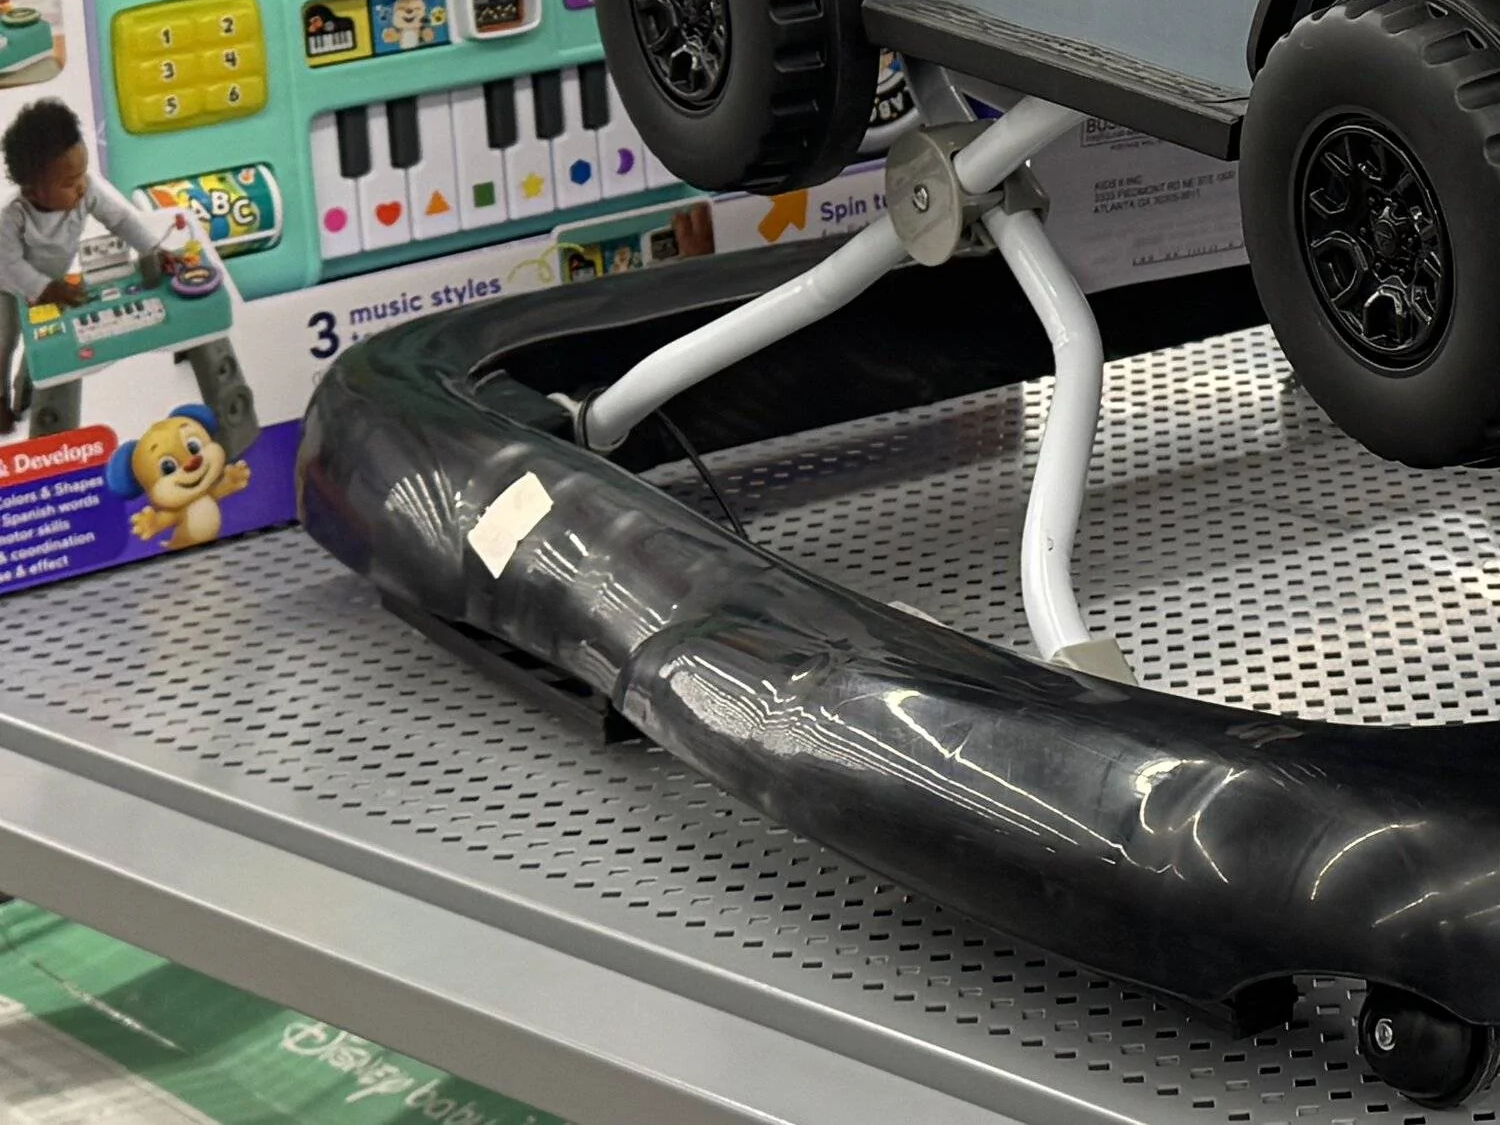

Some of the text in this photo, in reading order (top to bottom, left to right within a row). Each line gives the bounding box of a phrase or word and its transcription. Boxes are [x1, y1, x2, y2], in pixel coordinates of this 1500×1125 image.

[162, 17, 234, 45] 1 2
[163, 50, 237, 79] 3 4
[165, 86, 240, 114] 5 6
[820, 196, 866, 222] Spin
[308, 277, 502, 359] 3 music styles
[15, 441, 104, 474] Develops
[0, 491, 37, 510] olors
[54, 476, 104, 496] Shapes
[2, 494, 100, 527] Spanish words
[37, 520, 71, 536] skills
[10, 531, 96, 561] coordination
[29, 555, 69, 574] effect
